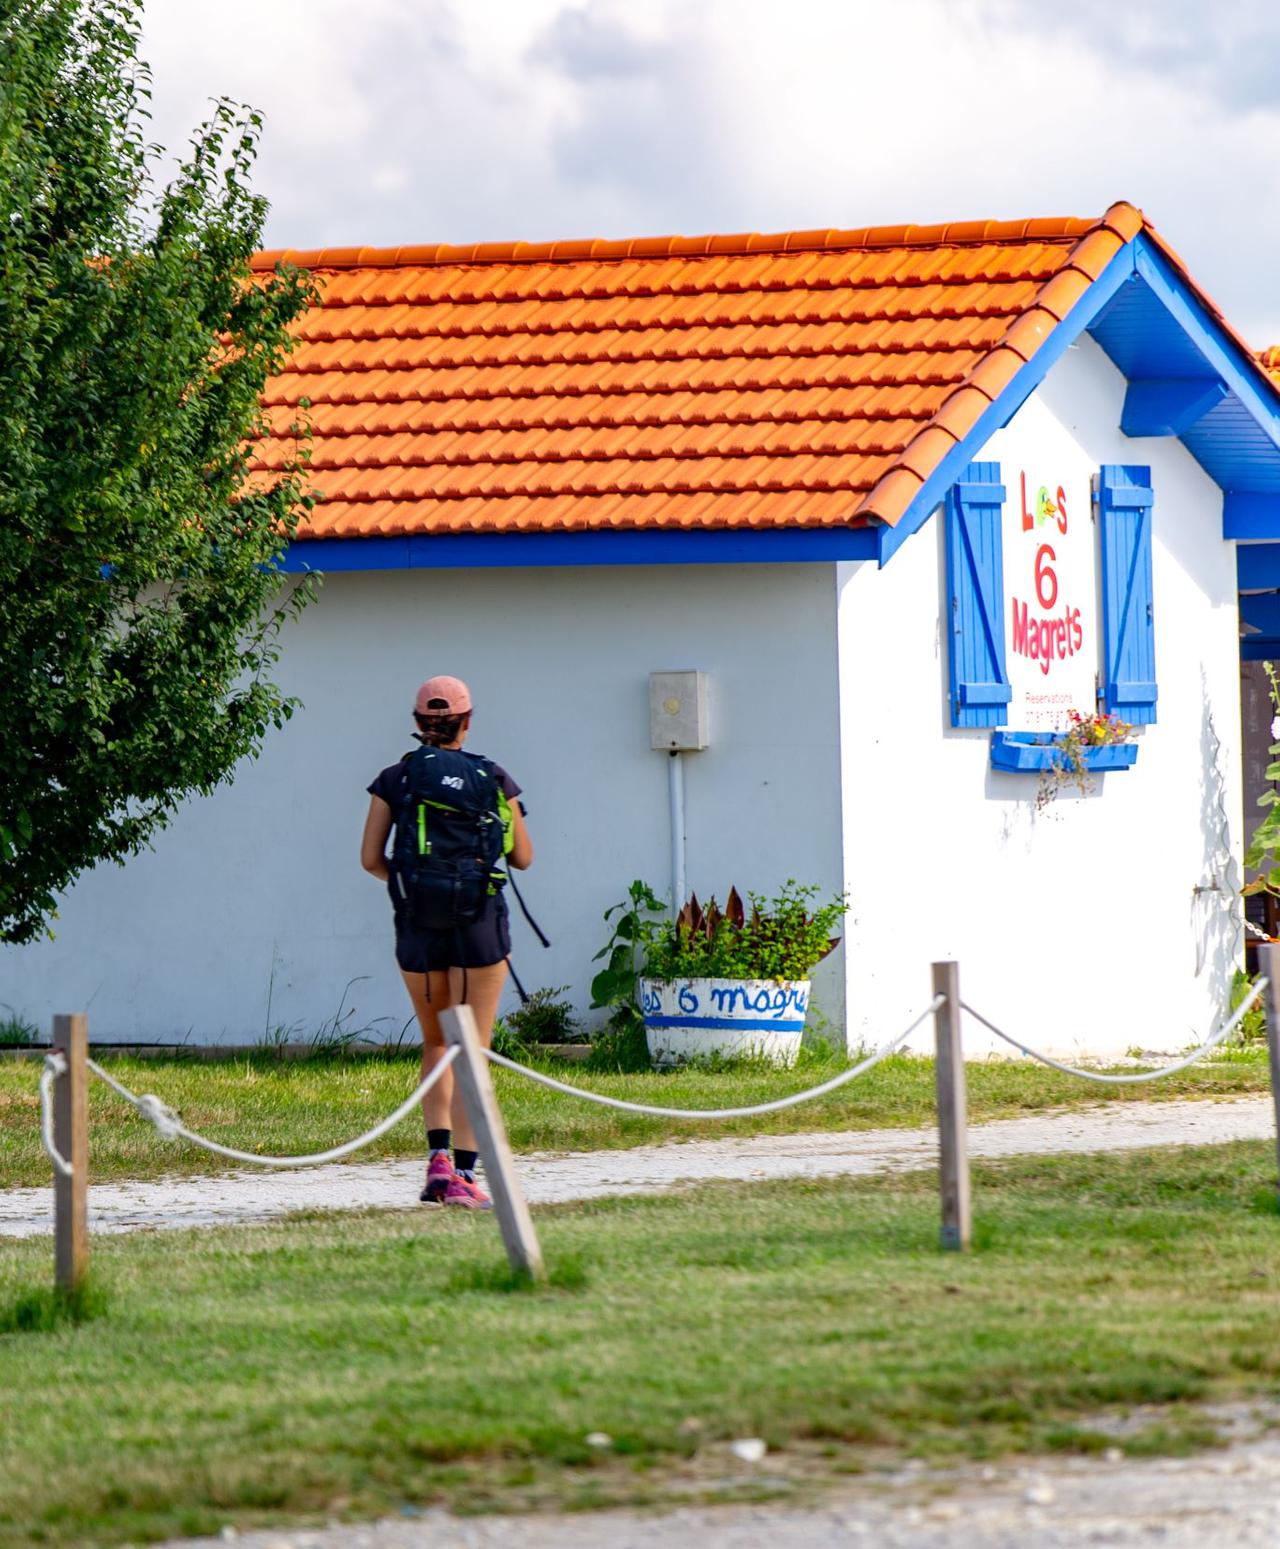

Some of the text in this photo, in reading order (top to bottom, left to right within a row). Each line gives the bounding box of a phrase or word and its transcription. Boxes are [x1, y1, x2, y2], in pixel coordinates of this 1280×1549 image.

[1034, 543, 1058, 610] 6
[1012, 596, 1083, 676] Magrets
[678, 986, 699, 1013] 6
